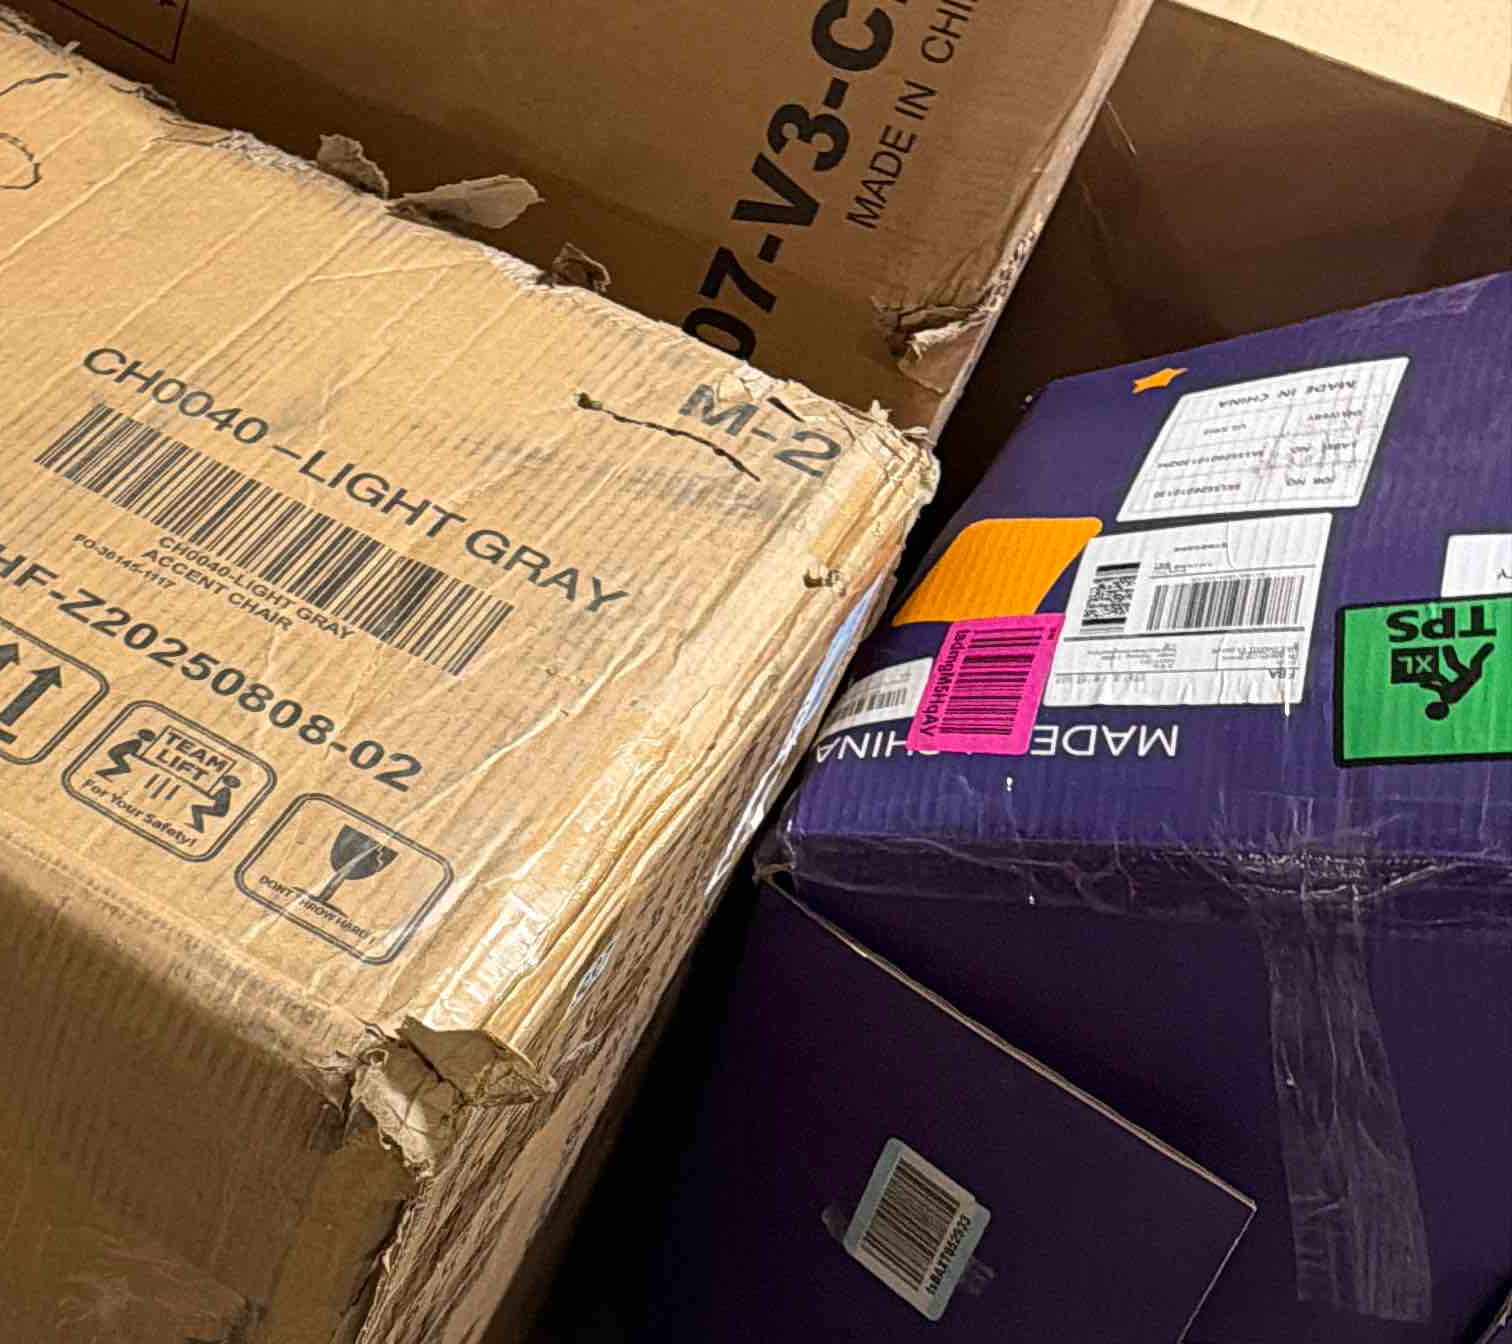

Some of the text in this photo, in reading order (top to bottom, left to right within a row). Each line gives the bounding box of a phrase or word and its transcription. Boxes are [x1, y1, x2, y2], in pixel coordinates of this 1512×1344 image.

[846, 122, 920, 230] MADE
[892, 81, 934, 137] IN
[678, 383, 842, 479] M-2
[141, 548, 294, 632] ACCENT CHAIR
[159, 536, 356, 641] CH0040-LIGHT GRAY
[464, 529, 631, 614] GRAY
[1386, 606, 1497, 643] TPS
[1268, 668, 1297, 680] FBA
[1397, 655, 1433, 674] XL
[154, 748, 211, 782] LIFT
[166, 731, 229, 773] TEAM
[816, 724, 1179, 763] MADE HINA
[80, 777, 199, 848] For Your Safety!
